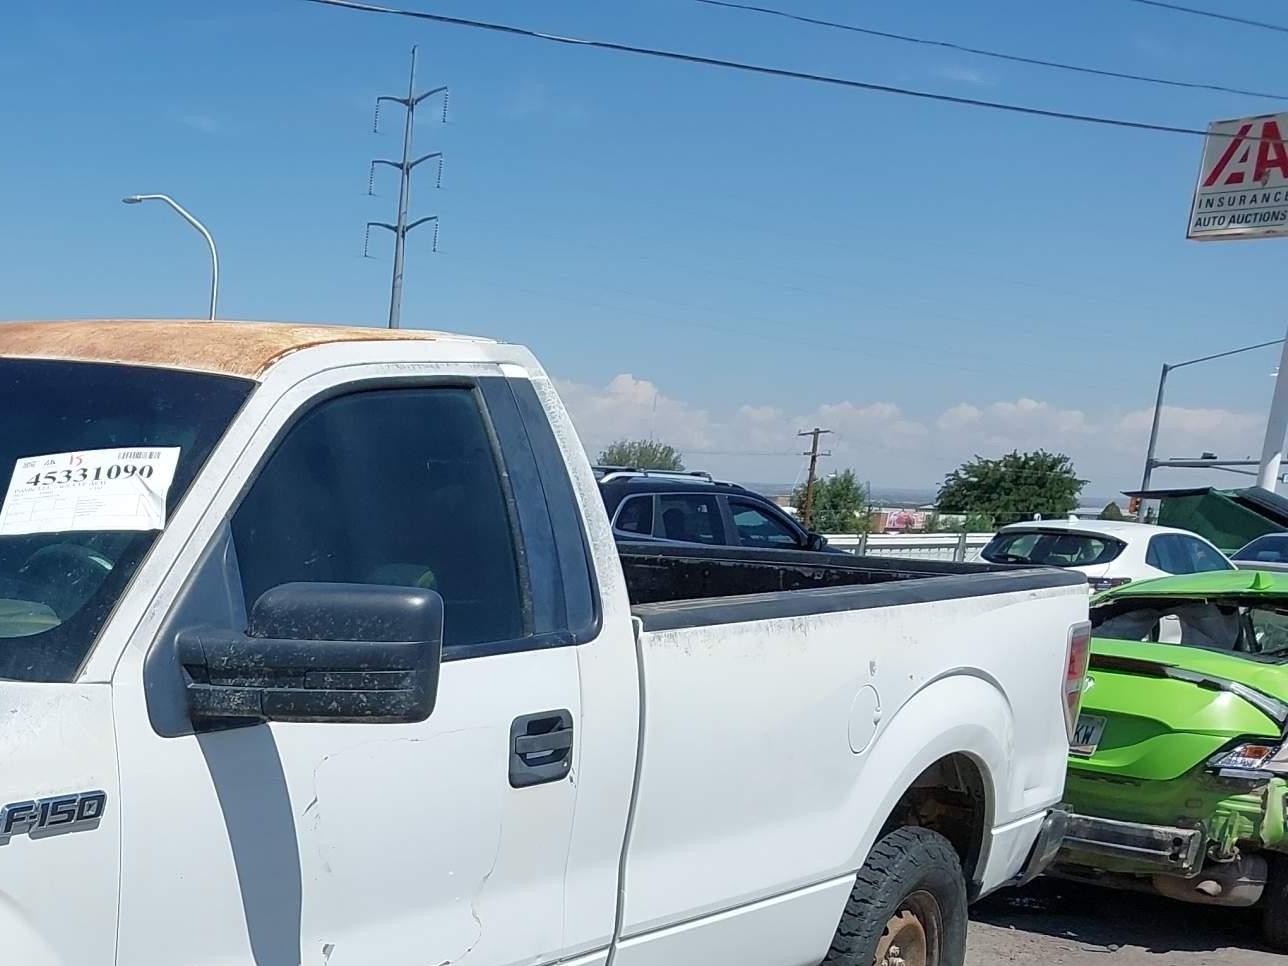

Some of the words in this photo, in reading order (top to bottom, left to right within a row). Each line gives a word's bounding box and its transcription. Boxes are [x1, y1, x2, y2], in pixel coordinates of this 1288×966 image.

[1194, 215, 1226, 227] AUTO
[26, 464, 154, 487] 45331090
[2, 791, 107, 836] F-150
